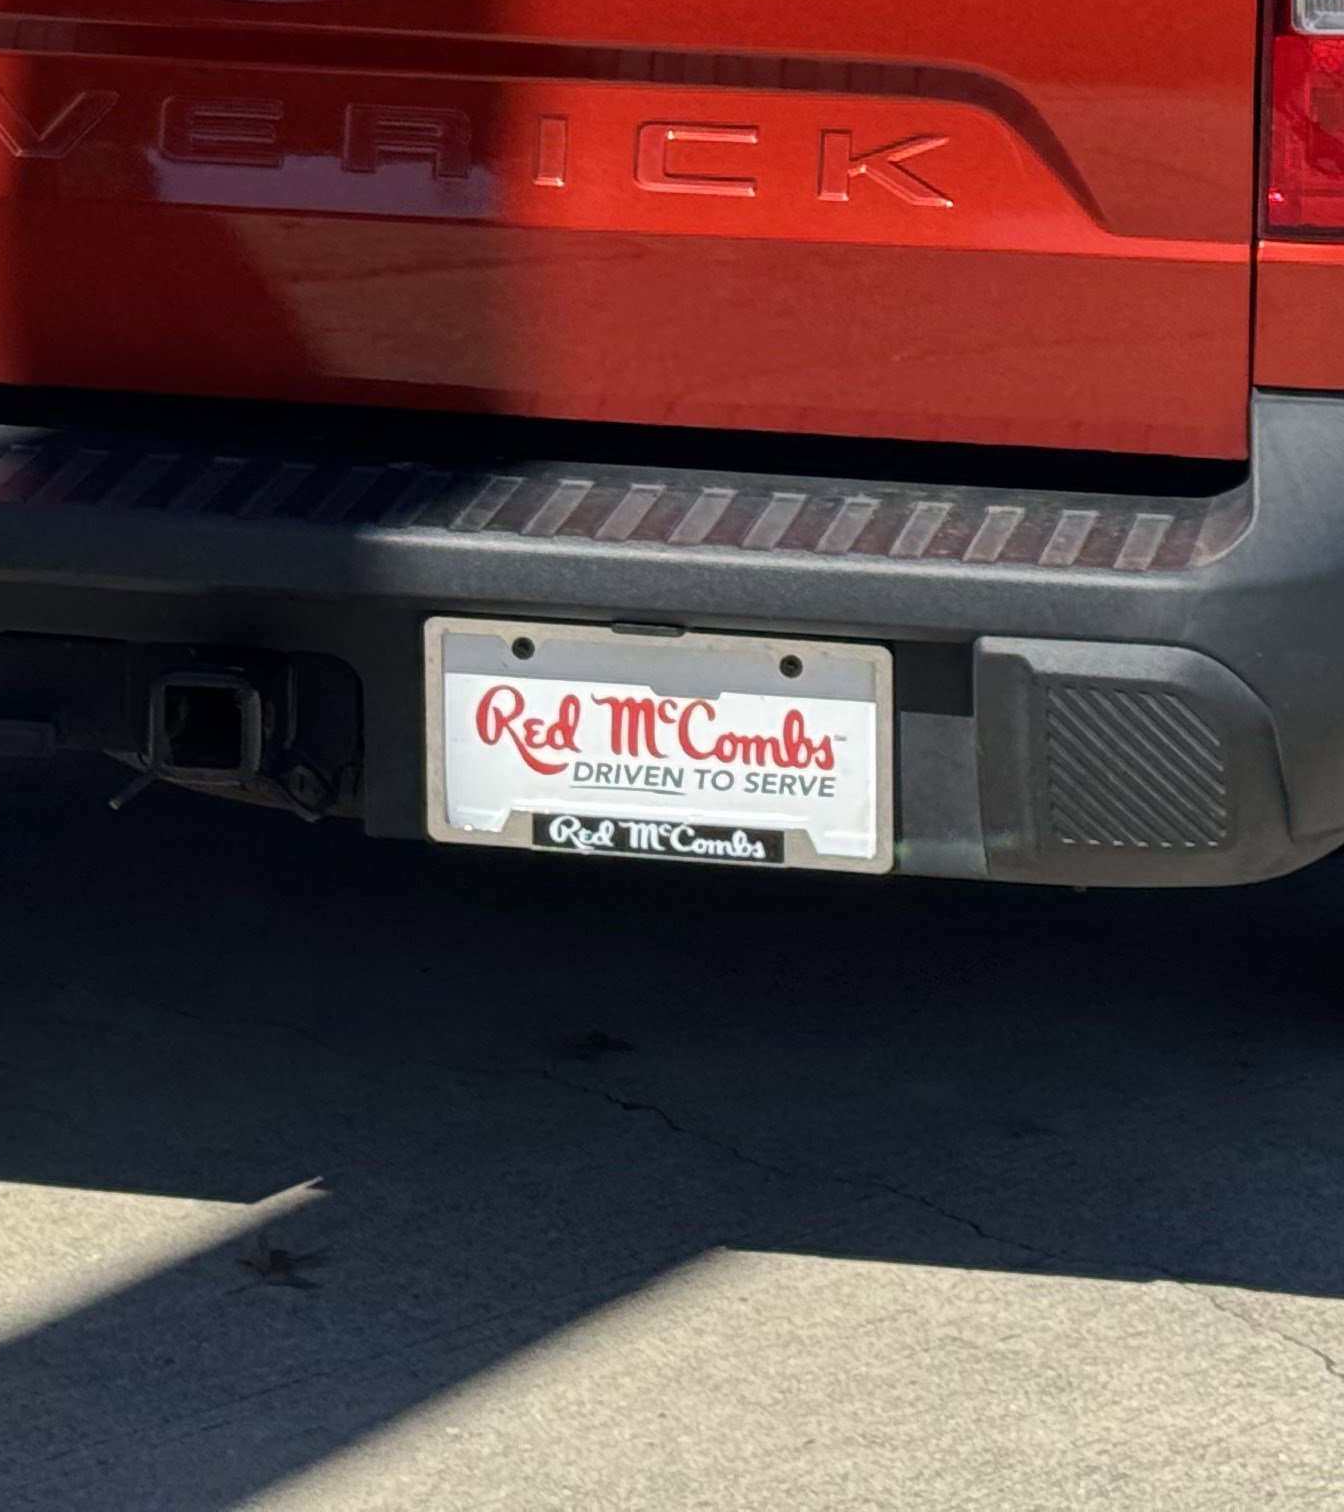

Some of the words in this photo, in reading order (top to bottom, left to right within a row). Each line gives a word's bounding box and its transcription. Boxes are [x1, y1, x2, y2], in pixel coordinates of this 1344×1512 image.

[476, 685, 583, 775] Red
[573, 761, 685, 790] DRIVEN
[694, 768, 735, 792] TO
[744, 772, 837, 798] SERVE
[549, 815, 615, 849] Red
[620, 821, 766, 859] McCombs
